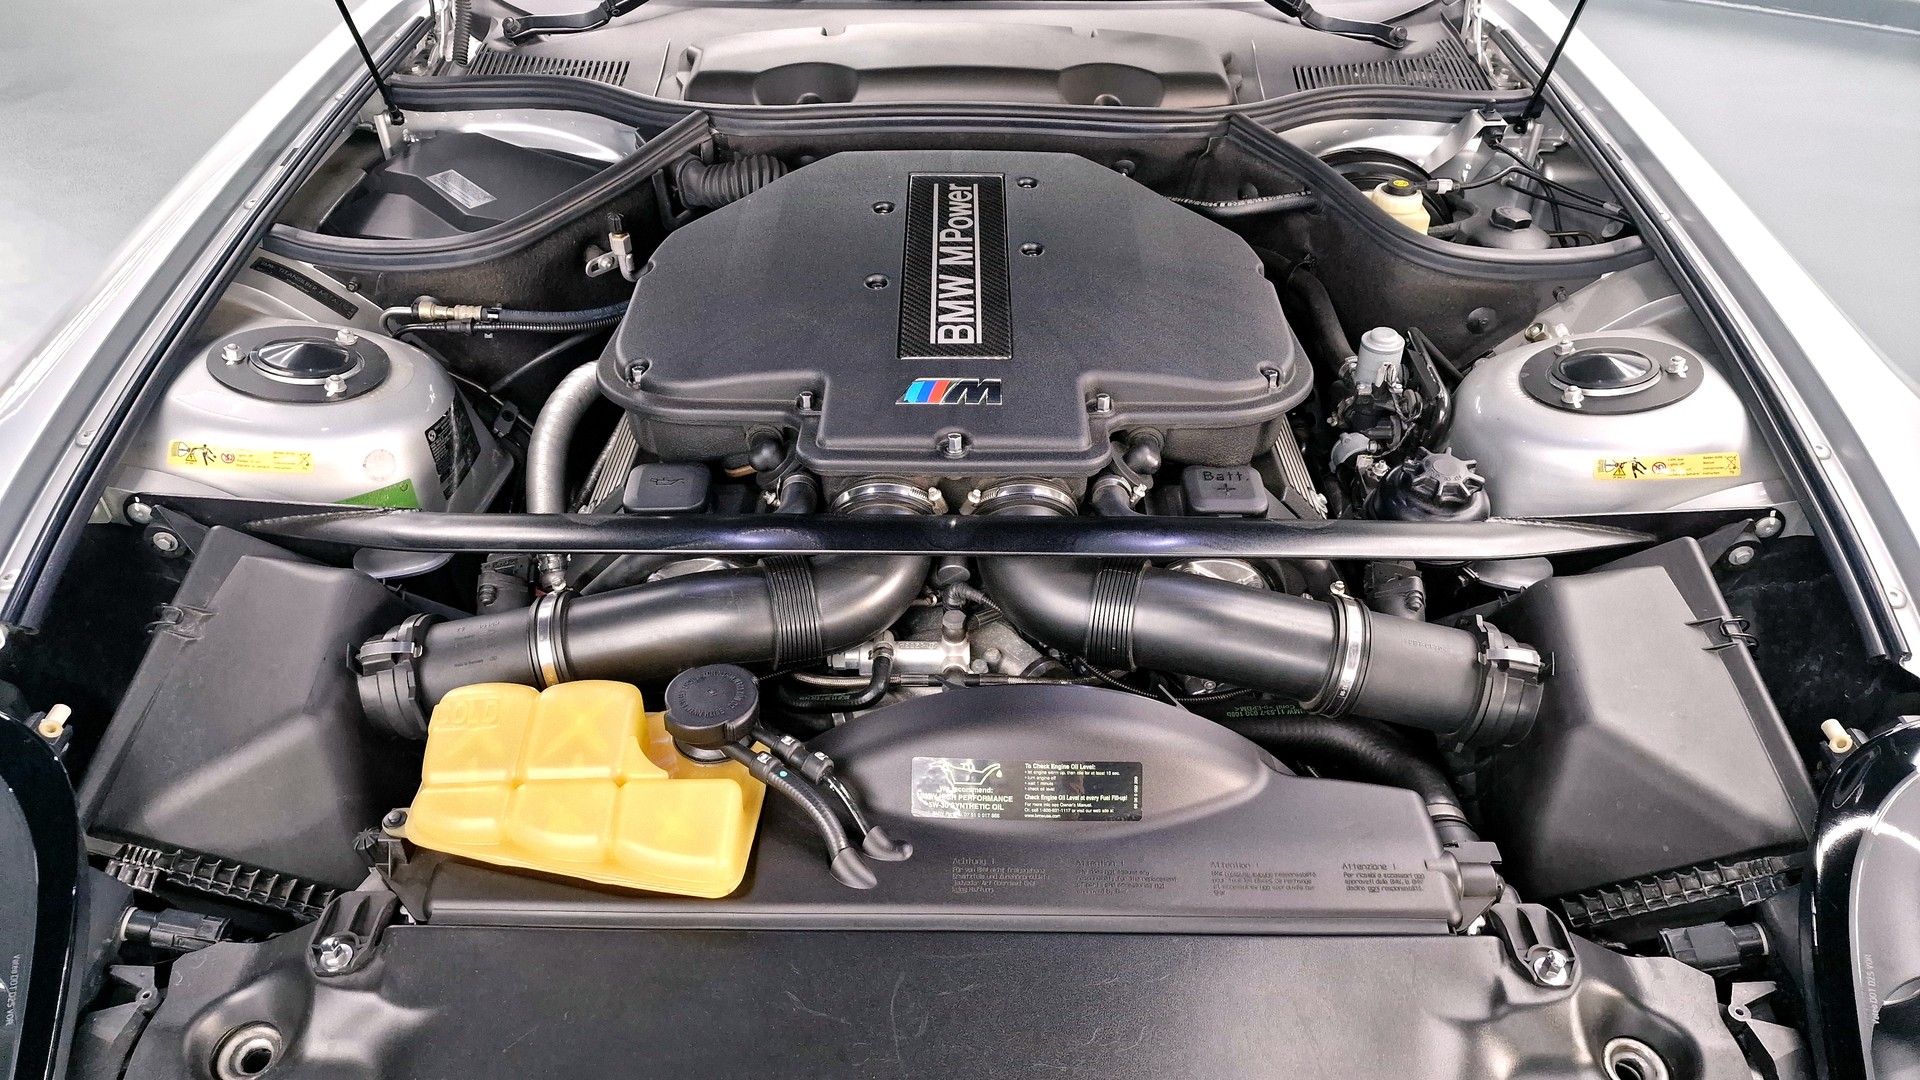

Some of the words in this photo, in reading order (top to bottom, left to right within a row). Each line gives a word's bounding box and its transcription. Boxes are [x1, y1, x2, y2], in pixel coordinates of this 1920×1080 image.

[937, 274, 975, 344] BMW
[1203, 471, 1249, 482] Batt.
[959, 794, 1014, 802] PERFORMANCE
[1865, 954, 1874, 969] VOR
[6, 1009, 14, 1026] VOR
